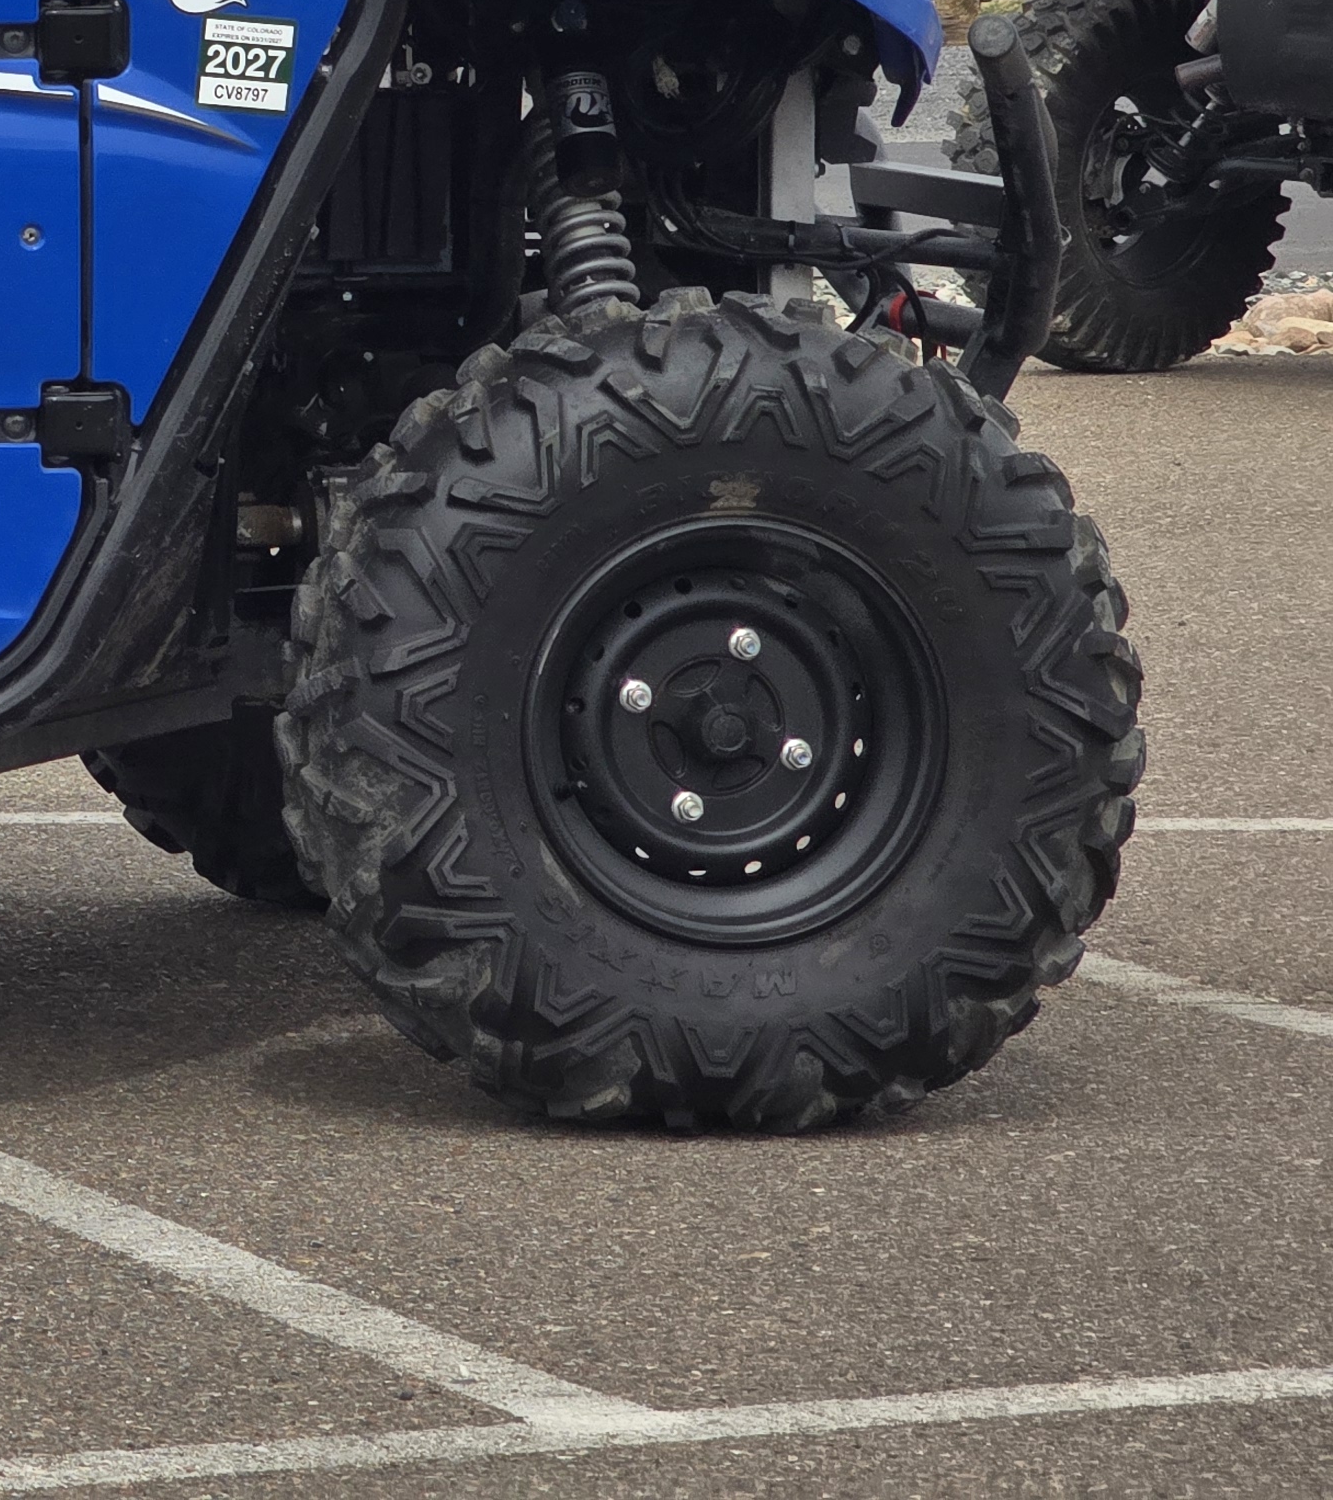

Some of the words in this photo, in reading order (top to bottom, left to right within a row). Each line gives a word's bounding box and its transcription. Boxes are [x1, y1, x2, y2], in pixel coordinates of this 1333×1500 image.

[211, 32, 240, 41] EXPIRES
[214, 23, 235, 31] STATE
[247, 26, 283, 36] COLORADO
[204, 44, 287, 79] 2027
[214, 84, 269, 103] CV8797
